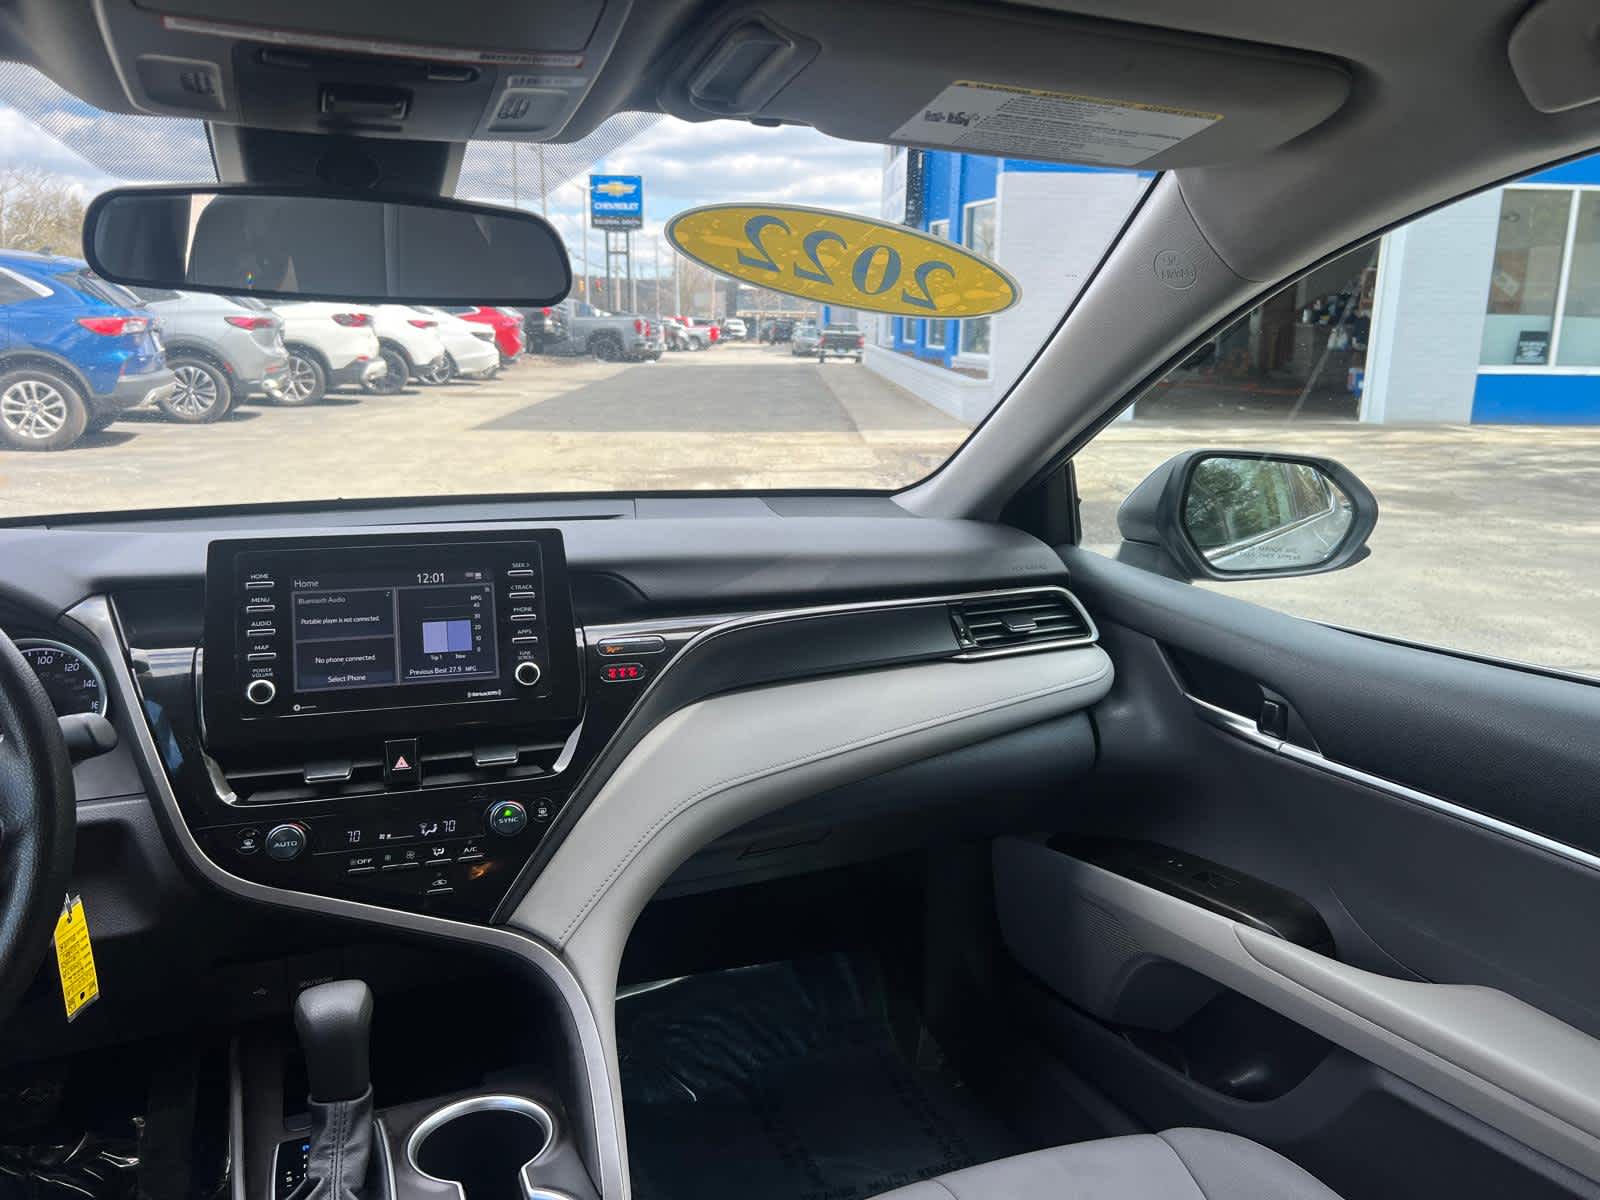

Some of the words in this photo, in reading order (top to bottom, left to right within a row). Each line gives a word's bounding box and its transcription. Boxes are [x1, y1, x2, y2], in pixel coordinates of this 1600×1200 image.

[594, 202, 639, 210] CHEVROLET
[416, 572, 446, 584] 12:01
[294, 579, 319, 588] Home
[323, 616, 338, 624] player
[37, 655, 54, 665] 100
[326, 656, 345, 664] phone
[64, 663, 80, 672] 120
[409, 668, 434, 676] Previous
[465, 664, 477, 672] MPG
[327, 675, 346, 683] Select
[91, 700, 99, 709] 16
[499, 816, 519, 824] SYNC
[443, 819, 456, 832] 70
[347, 830, 361, 843] 70
[273, 840, 298, 849] AUTO
